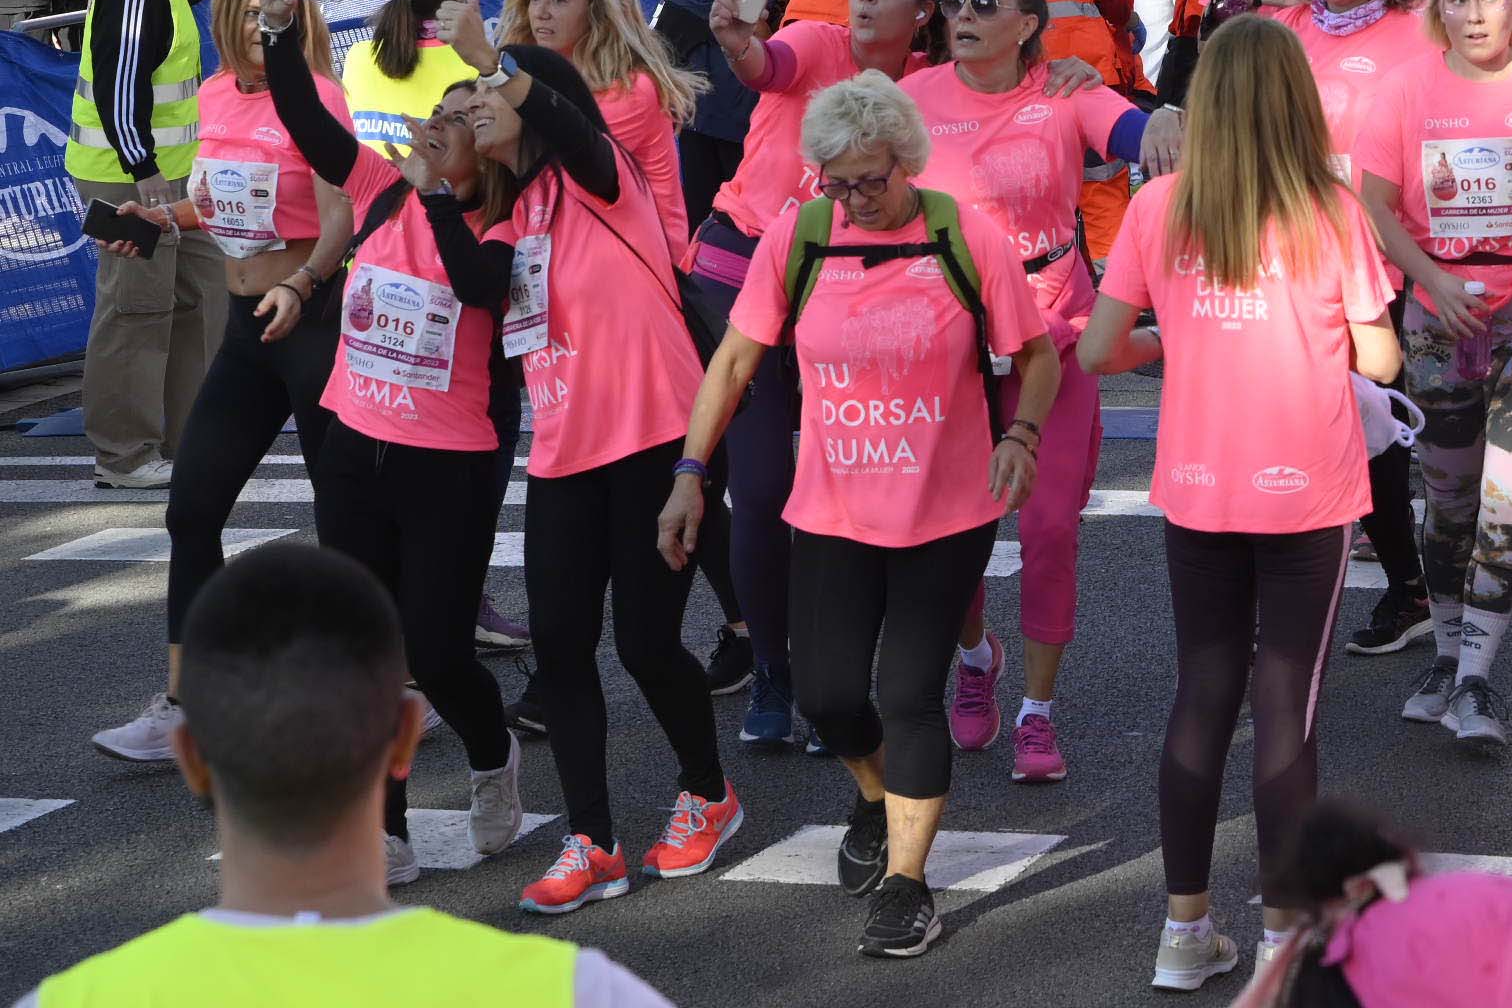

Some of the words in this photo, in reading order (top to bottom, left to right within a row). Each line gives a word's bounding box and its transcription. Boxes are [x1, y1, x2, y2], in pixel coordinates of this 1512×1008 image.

[932, 121, 979, 136] OYSHO
[1425, 118, 1469, 129] OYSHO
[1460, 177, 1496, 192] 016
[216, 199, 245, 214] 016
[1466, 195, 1493, 205] 12363
[222, 217, 244, 227] 16053
[1440, 222, 1469, 232] OYSHO
[1197, 277, 1226, 297] DE
[1243, 280, 1265, 299] LA
[1192, 299, 1269, 321] MUJER
[376, 313, 415, 336] 016
[380, 334, 404, 348] 3124
[402, 370, 440, 382] Santander
[814, 362, 850, 388] TU
[822, 396, 946, 426] DORSAL
[826, 438, 917, 465] SUMA
[1171, 468, 1216, 487] OYSHO
[1256, 474, 1306, 488] ASTURIANA
